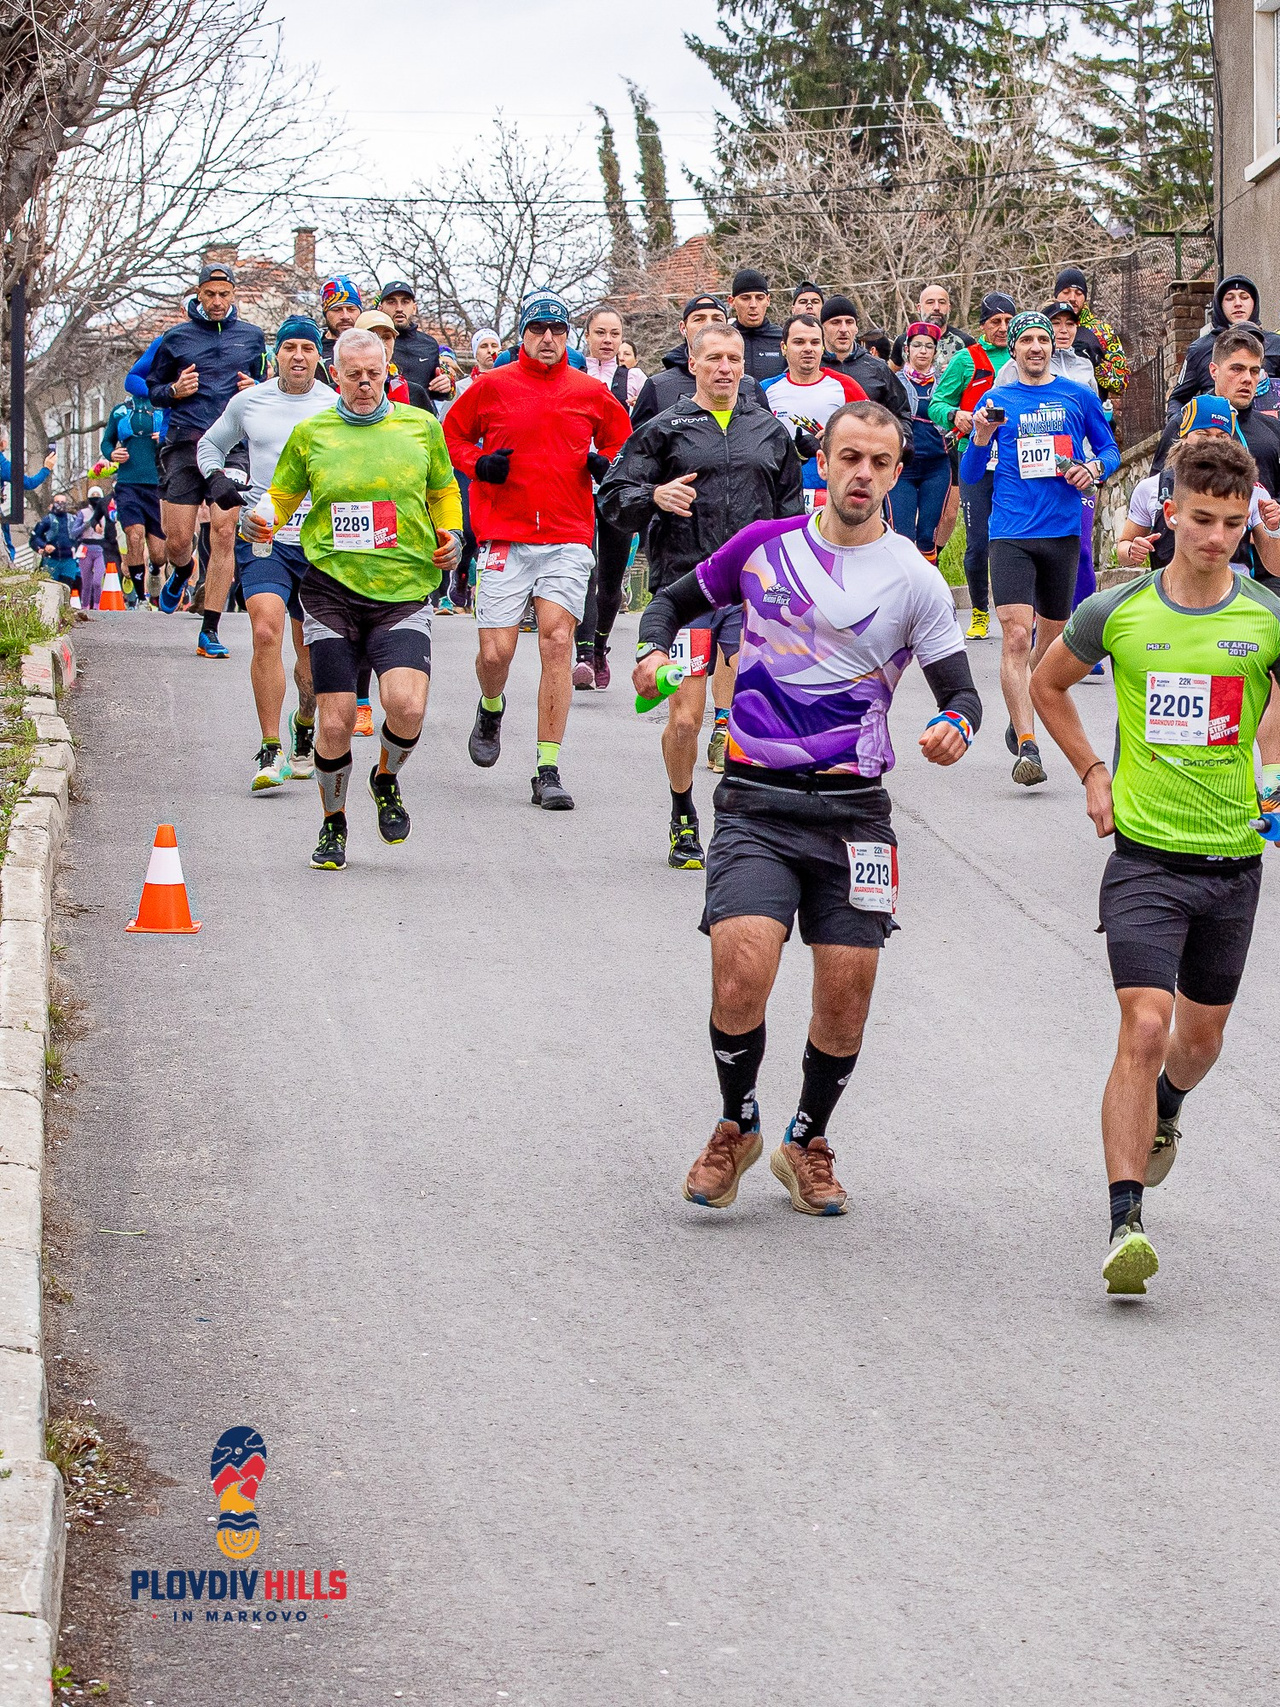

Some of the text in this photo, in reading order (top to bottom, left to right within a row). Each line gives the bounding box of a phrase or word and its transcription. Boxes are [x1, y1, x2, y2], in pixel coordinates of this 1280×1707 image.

[1021, 448, 1050, 463] 2107
[334, 516, 370, 532] 2289
[671, 643, 684, 659] 91
[1229, 648, 1247, 656] 2013
[1231, 641, 1258, 651] АКТИВ
[1149, 693, 1204, 719] 2205
[1149, 718, 1175, 726] MARKOVO
[855, 861, 890, 887] 2213
